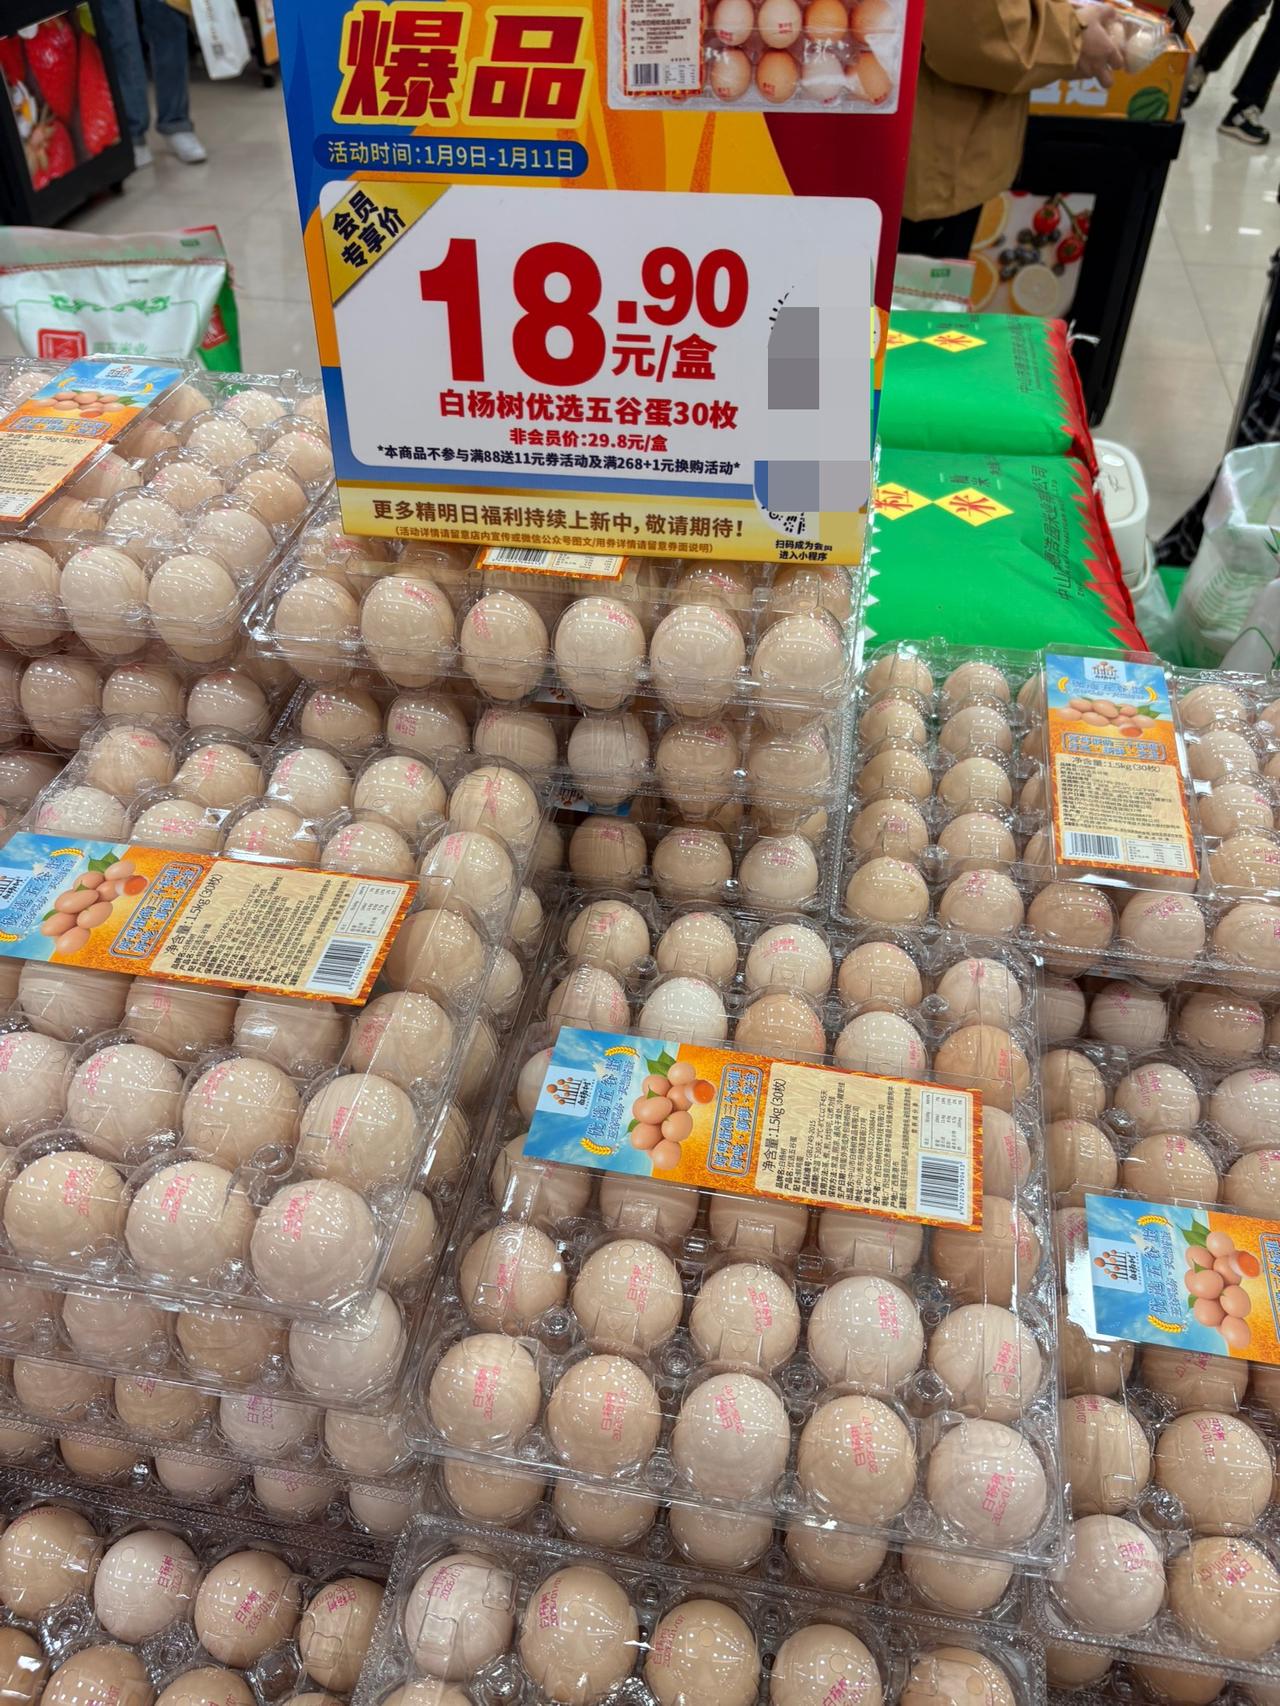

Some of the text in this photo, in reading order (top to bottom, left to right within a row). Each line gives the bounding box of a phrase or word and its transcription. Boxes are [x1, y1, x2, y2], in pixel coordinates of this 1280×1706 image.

[340, 10, 587, 120] 爆品
[333, 190, 378, 242] 会员
[341, 206, 406, 268] 专享价
[612, 333, 718, 382] 元/盒
[440, 390, 740, 429] 白杨树优选五谷蛋30枚
[576, 1081, 591, 1105] 白杨树
[1126, 1253, 1138, 1281] 白杨树
[157, 1555, 175, 1587] 白杨树
[234, 1590, 262, 1624] 白杨树
